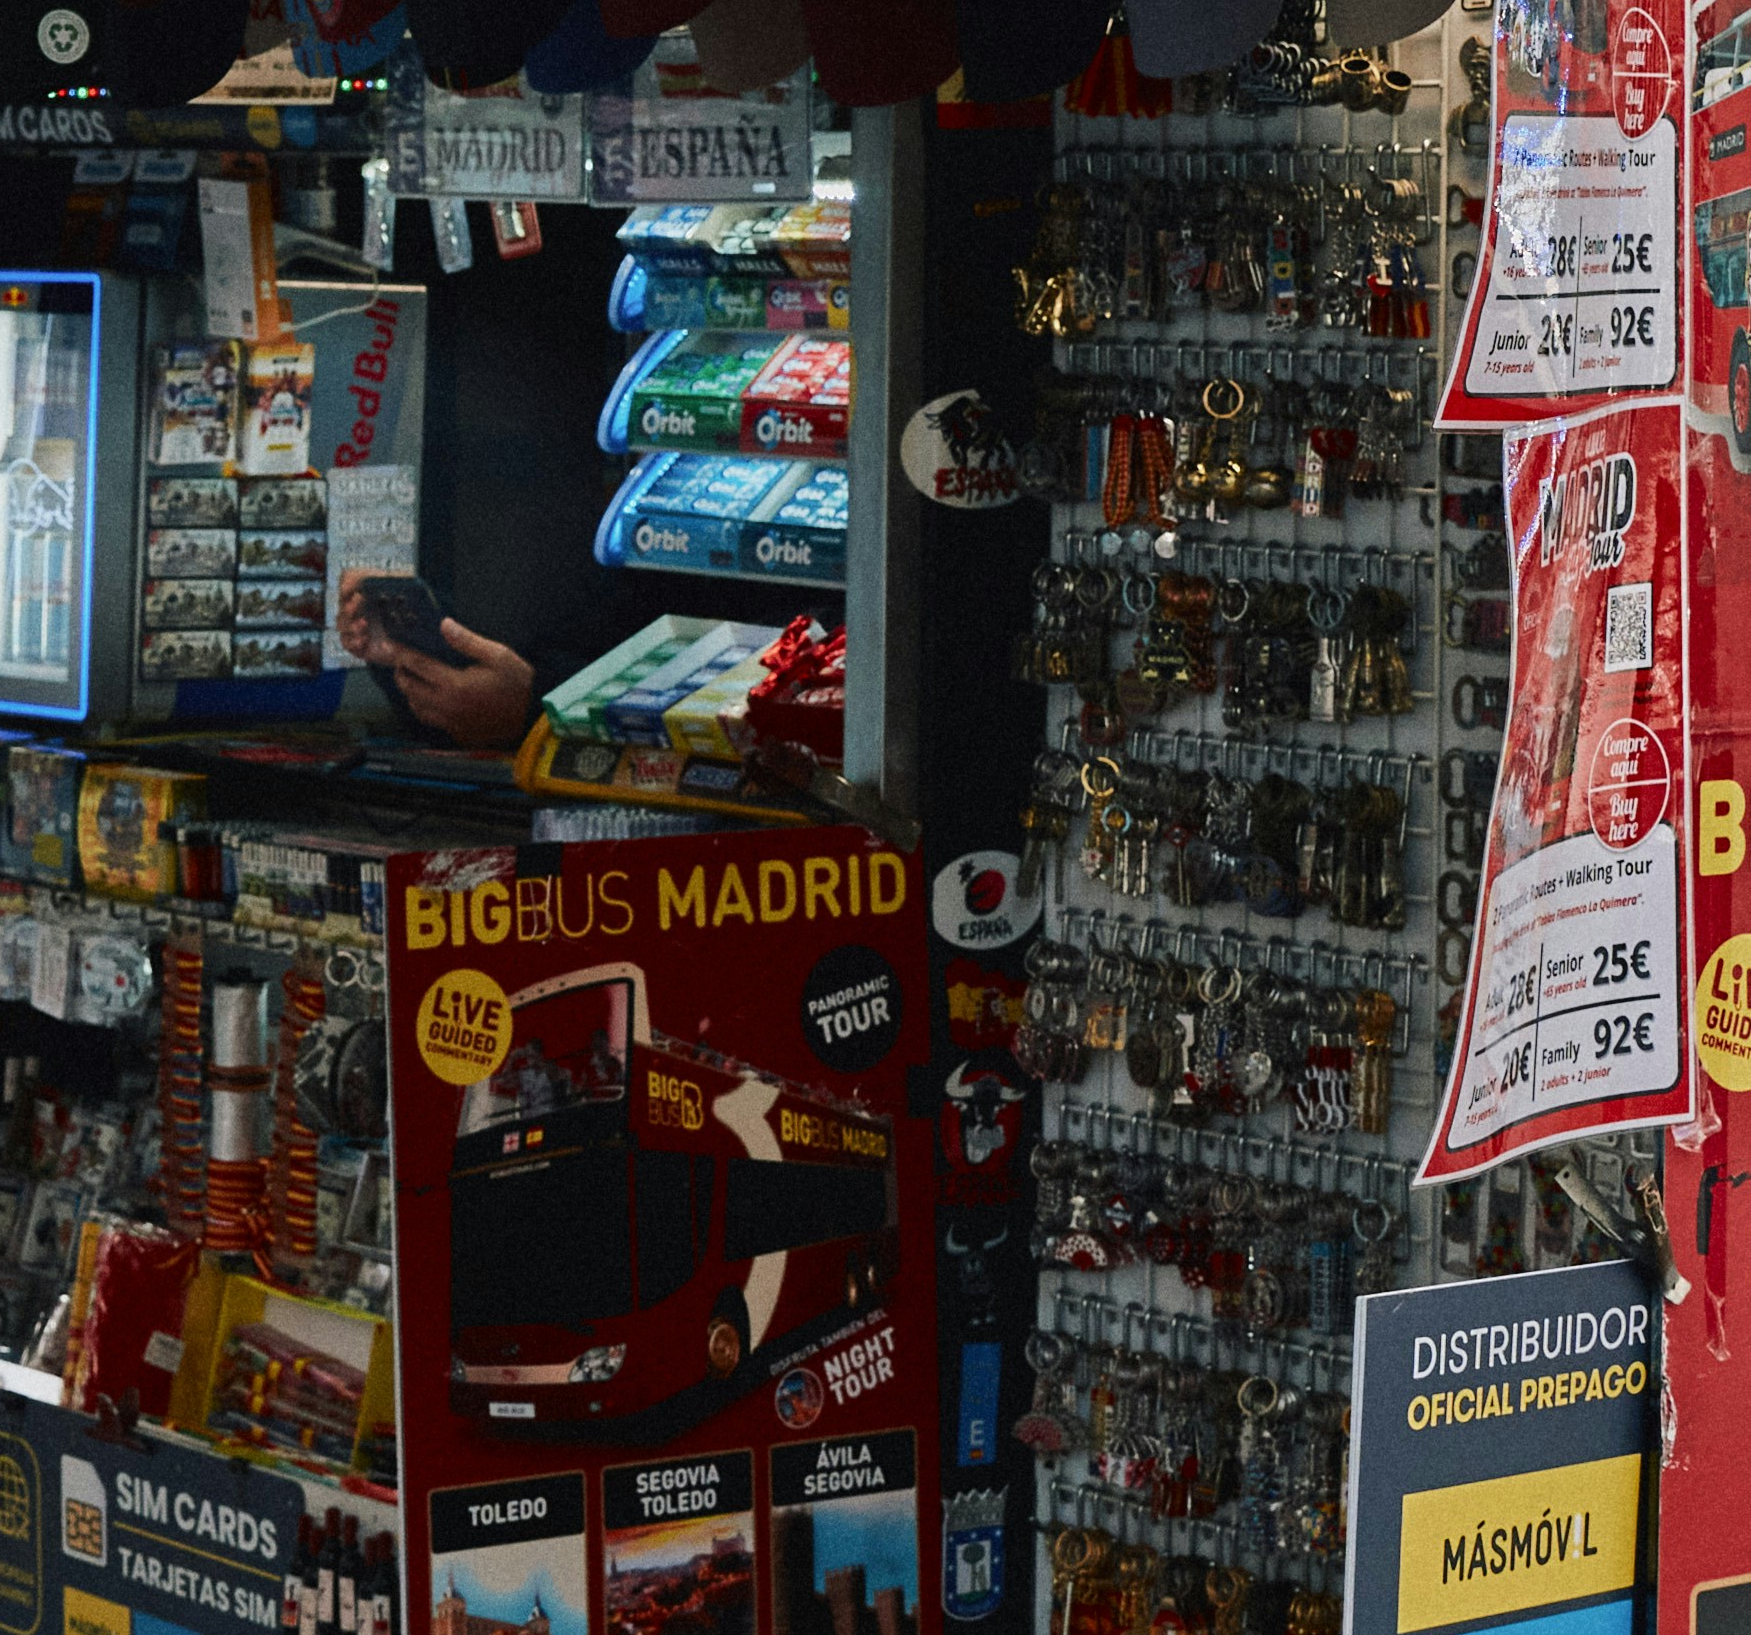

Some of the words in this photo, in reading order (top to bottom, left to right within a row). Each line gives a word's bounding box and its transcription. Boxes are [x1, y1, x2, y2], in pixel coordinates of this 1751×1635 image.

[432, 124, 567, 175] MADRID
[638, 114, 790, 180] ESPAÑA
[1628, 148, 1656, 168] Tour
[1612, 232, 1653, 275] 25€
[353, 298, 402, 384] Bull
[1488, 329, 1531, 357] Junior
[1610, 305, 1655, 349] 92€
[334, 386, 382, 469] Red
[641, 408, 696, 438] Orbit
[755, 415, 814, 445] Orbit
[635, 526, 689, 553] Orbit
[755, 536, 811, 568] Orbit
[1603, 735, 1649, 759] Compre
[1610, 752, 1640, 782] aquí
[1610, 793, 1639, 822] Buy
[1608, 820, 1639, 844] here
[658, 851, 907, 933] MADRID
[1566, 864, 1613, 889] Walking
[1616, 859, 1654, 878] Tour
[1546, 954, 1584, 980] Senior
[1593, 939, 1653, 987] 25€
[807, 973, 890, 1016] PANORAMIC
[429, 1022, 498, 1053] GUIDED
[816, 996, 893, 1046] TOUR
[1542, 1041, 1580, 1068] Family
[1594, 1012, 1654, 1061] 92€
[648, 1070, 683, 1102] BIG
[841, 1117, 888, 1159] MADRID
[823, 1326, 896, 1382] NIGHT
[1412, 1303, 1647, 1381] DISTRIBUIDOR
[829, 1356, 896, 1406] TOUR
[1407, 1383, 1514, 1431] OFICIAL
[1518, 1359, 1647, 1413] PREPAGO
[815, 1442, 873, 1470] ÁVILA
[636, 1464, 720, 1495] SEGOVIA
[803, 1466, 885, 1497] SEGOVIA
[115, 1471, 169, 1527] SIM
[173, 1489, 279, 1561] CARDS
[468, 1497, 547, 1528] TOLEDO
[641, 1489, 718, 1519] TOLEDO
[118, 1544, 231, 1614] TARJETAS
[234, 1584, 278, 1630] SIM
